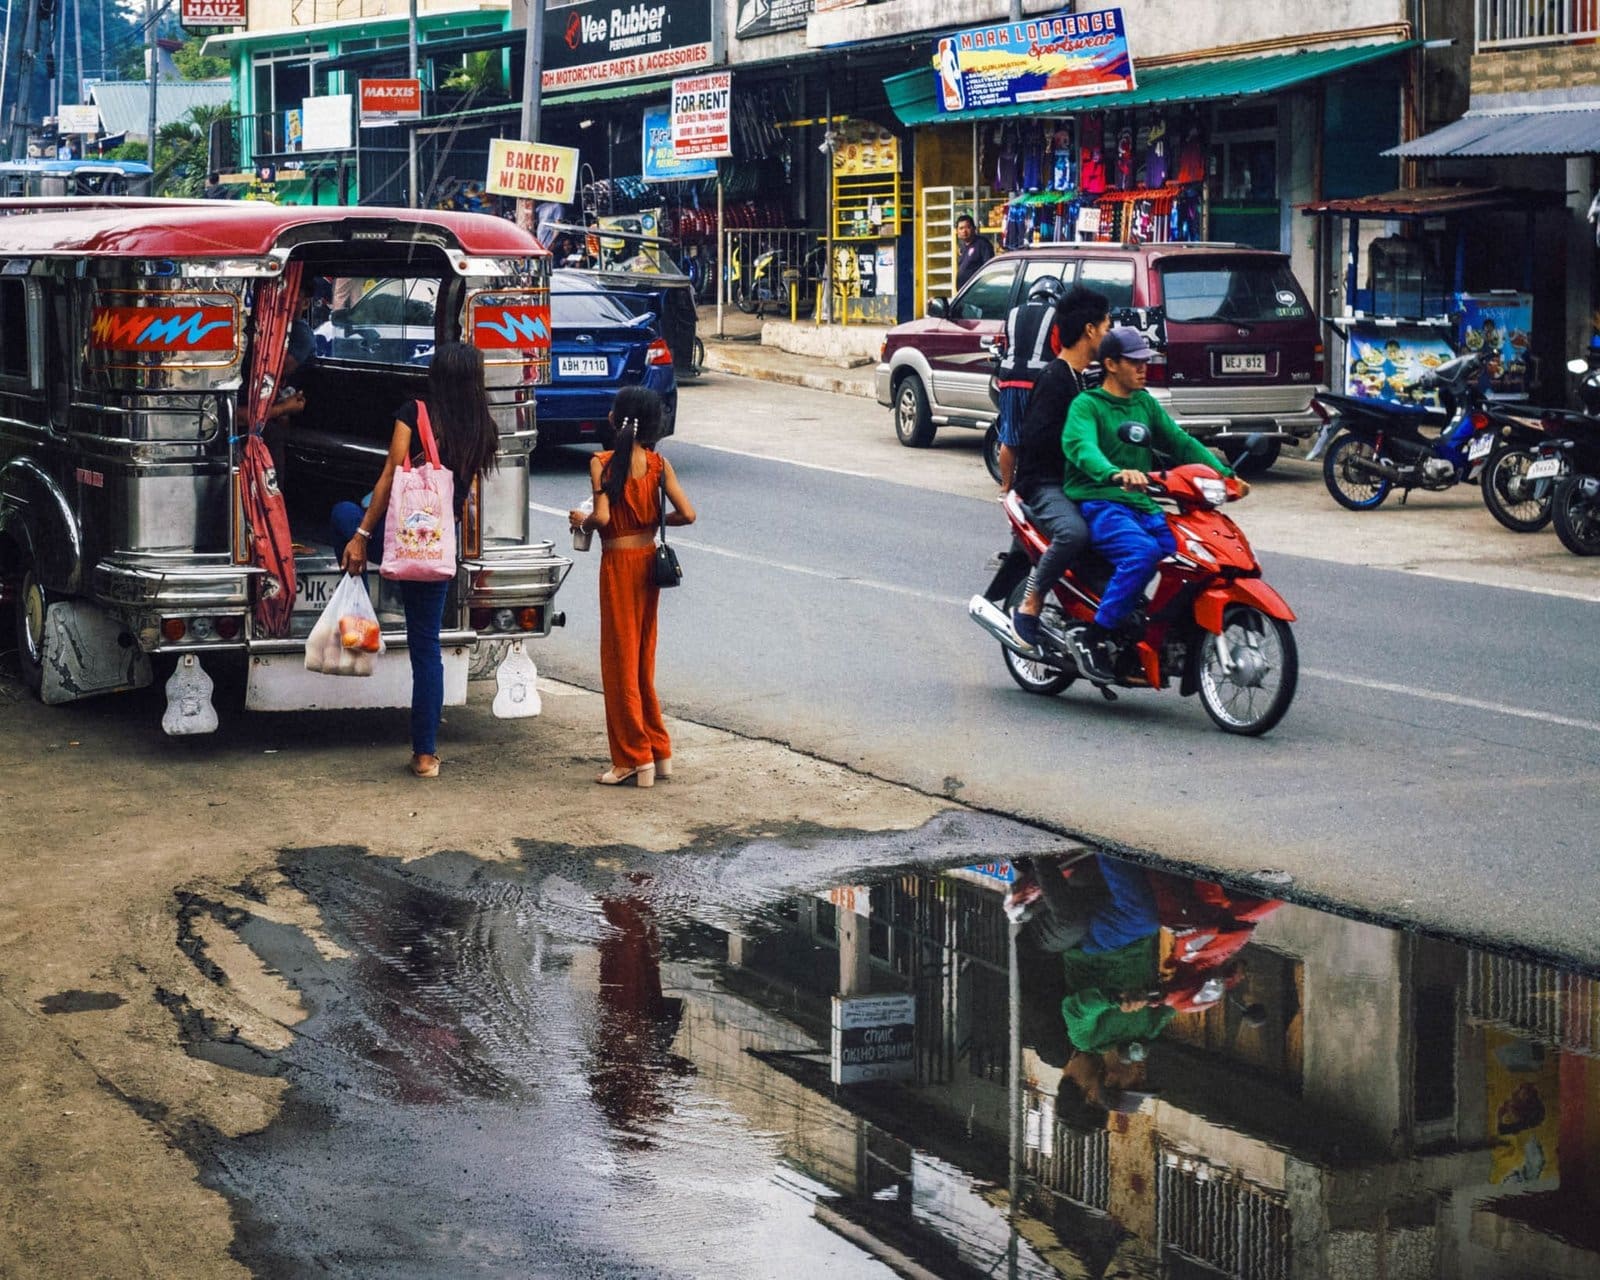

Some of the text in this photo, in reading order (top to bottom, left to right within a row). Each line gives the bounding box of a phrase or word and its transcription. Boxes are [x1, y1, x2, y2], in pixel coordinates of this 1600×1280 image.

[188, 4, 240, 16] HAUZ
[581, 4, 666, 43] Vee Rubber
[961, 12, 1115, 49] MARK LOURENCE
[1028, 33, 1115, 60] Sportswear
[556, 64, 607, 84] MOTORCYCLE
[610, 59, 635, 76] PARTS
[638, 58, 644, 72] &
[646, 46, 707, 70] ACCESSORIES
[364, 87, 415, 97] MAXXIS
[675, 90, 728, 113] FOR RENT
[506, 151, 559, 173] BAKERY
[499, 170, 564, 194] NI BUNSO
[562, 360, 605, 371] ABH 7110
[1246, 357, 1262, 368] 812
